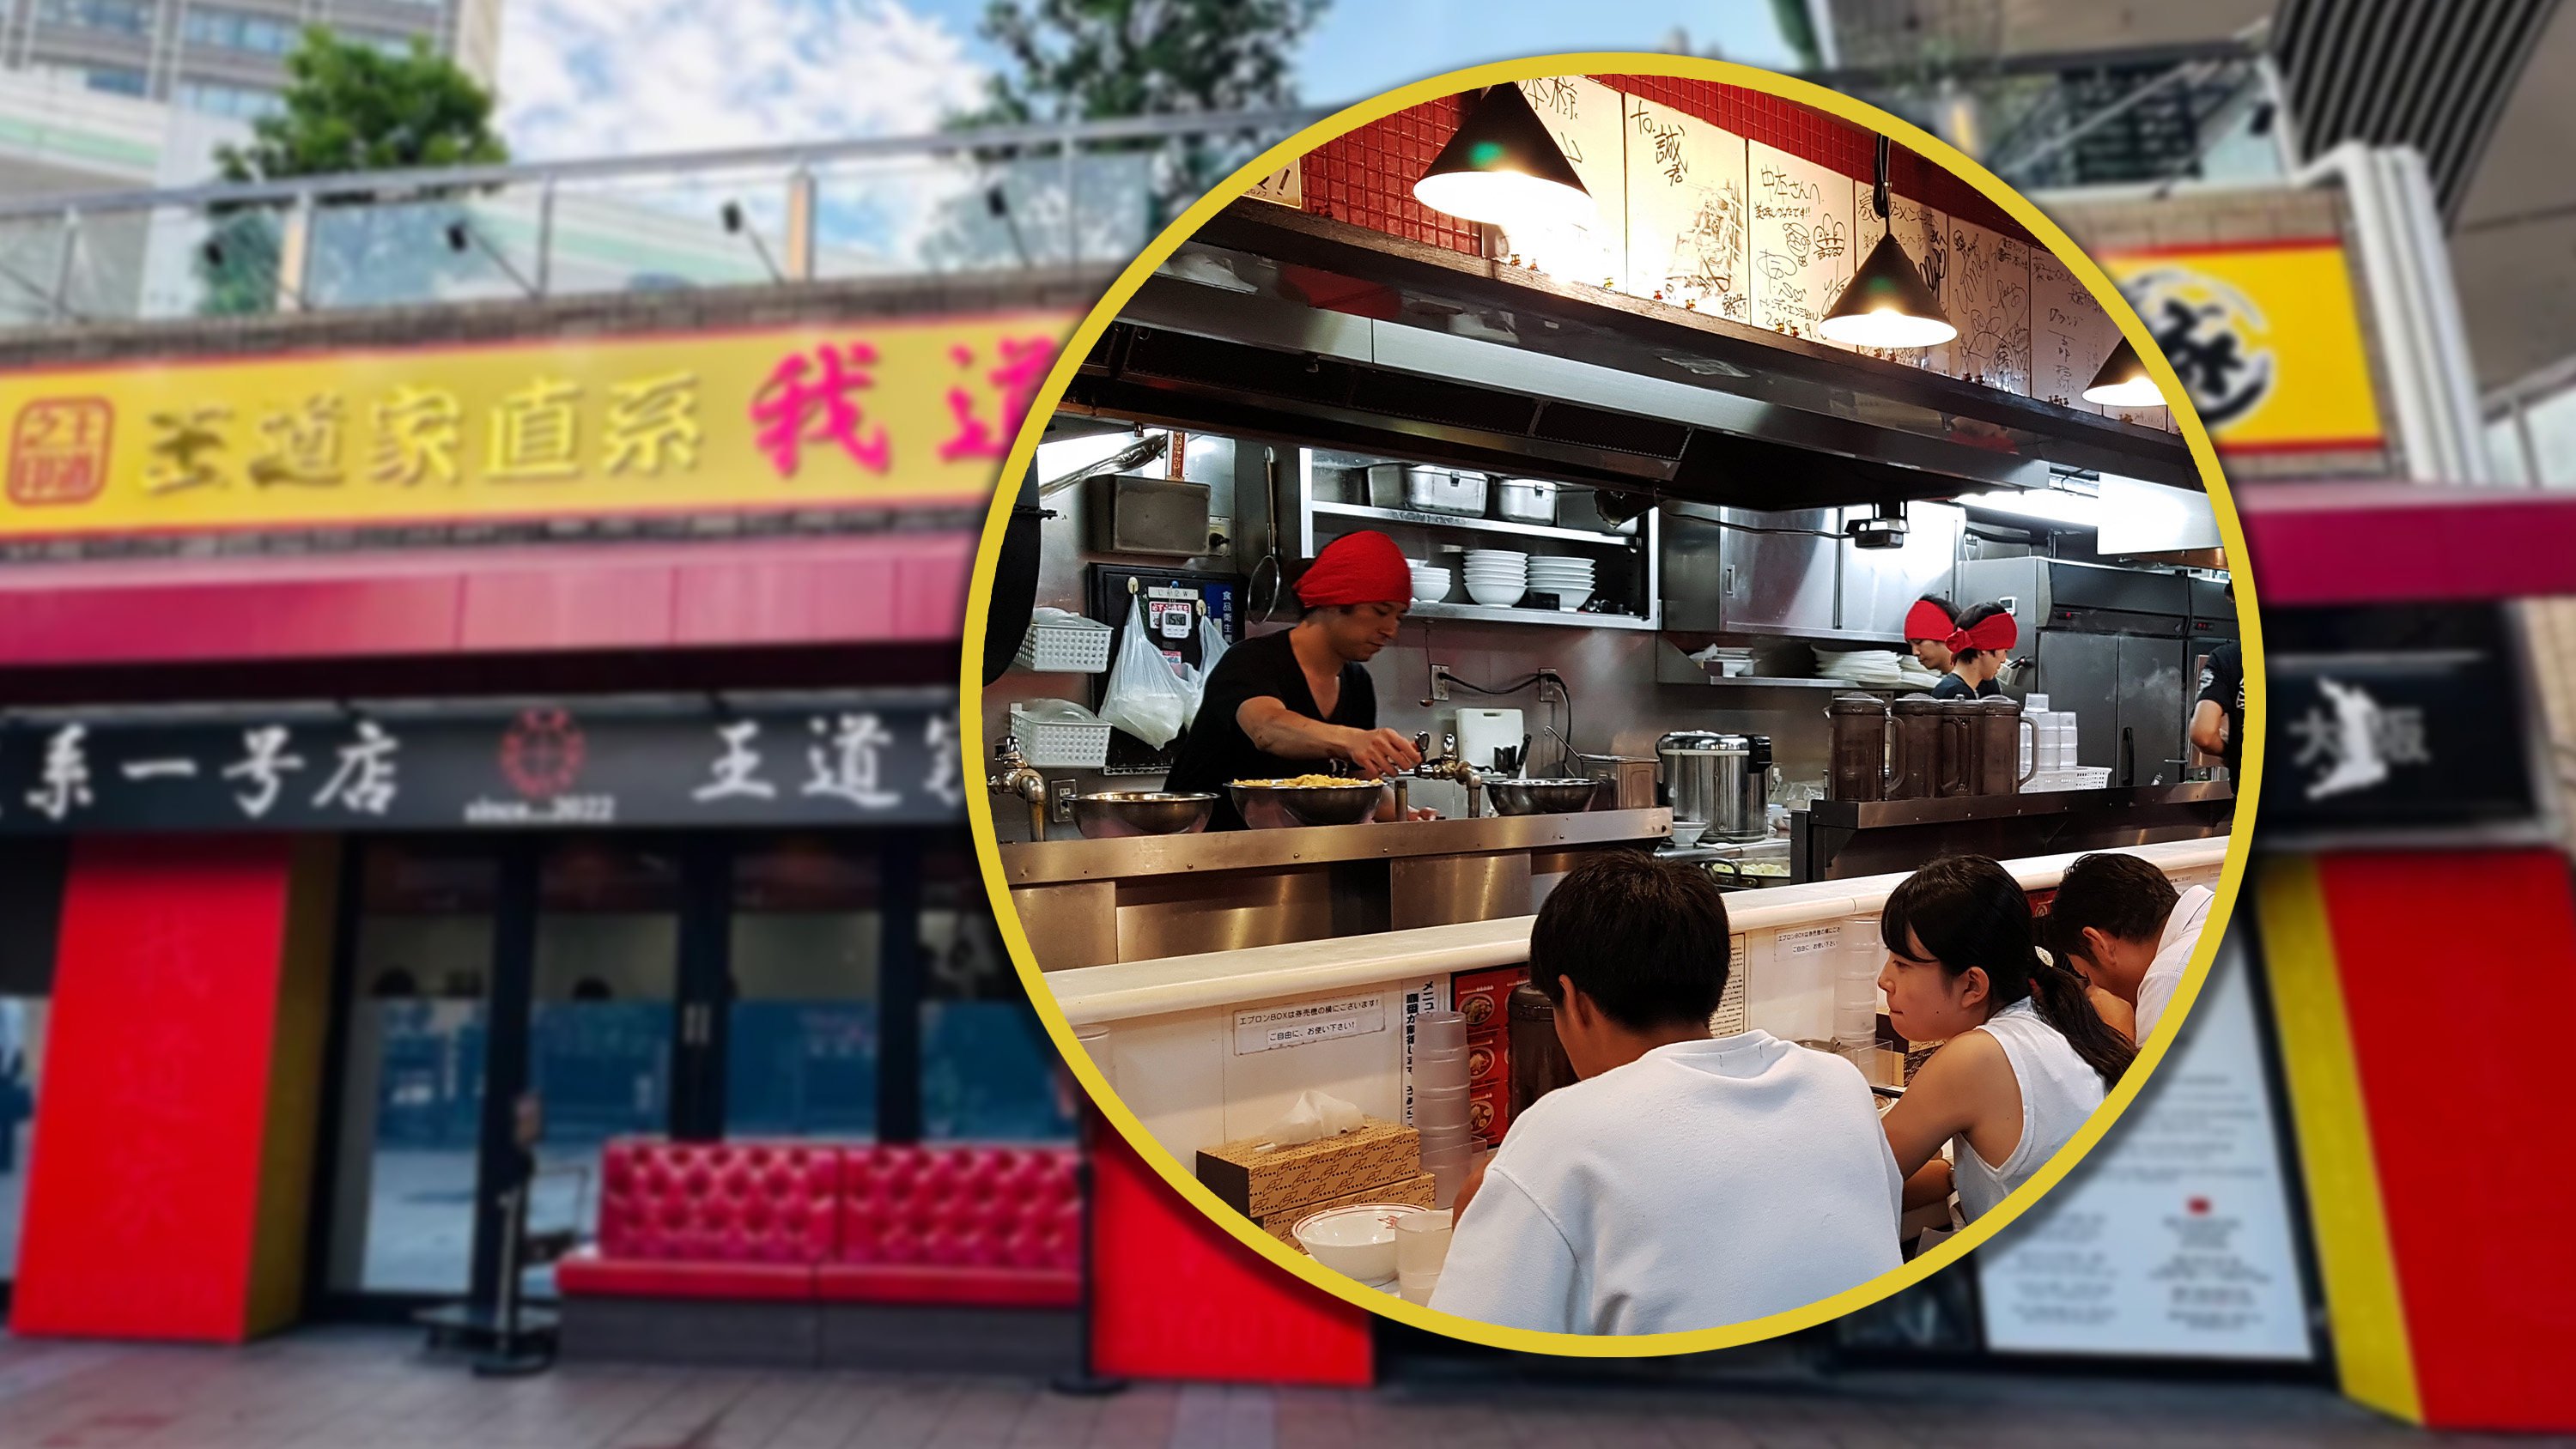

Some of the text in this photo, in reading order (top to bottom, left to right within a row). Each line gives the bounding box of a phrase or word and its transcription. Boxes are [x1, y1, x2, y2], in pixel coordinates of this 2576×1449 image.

[139, 370, 704, 495] 王道家直系
[26, 721, 401, 821] 系一号店
[1422, 980, 1434, 1015] メニュ
